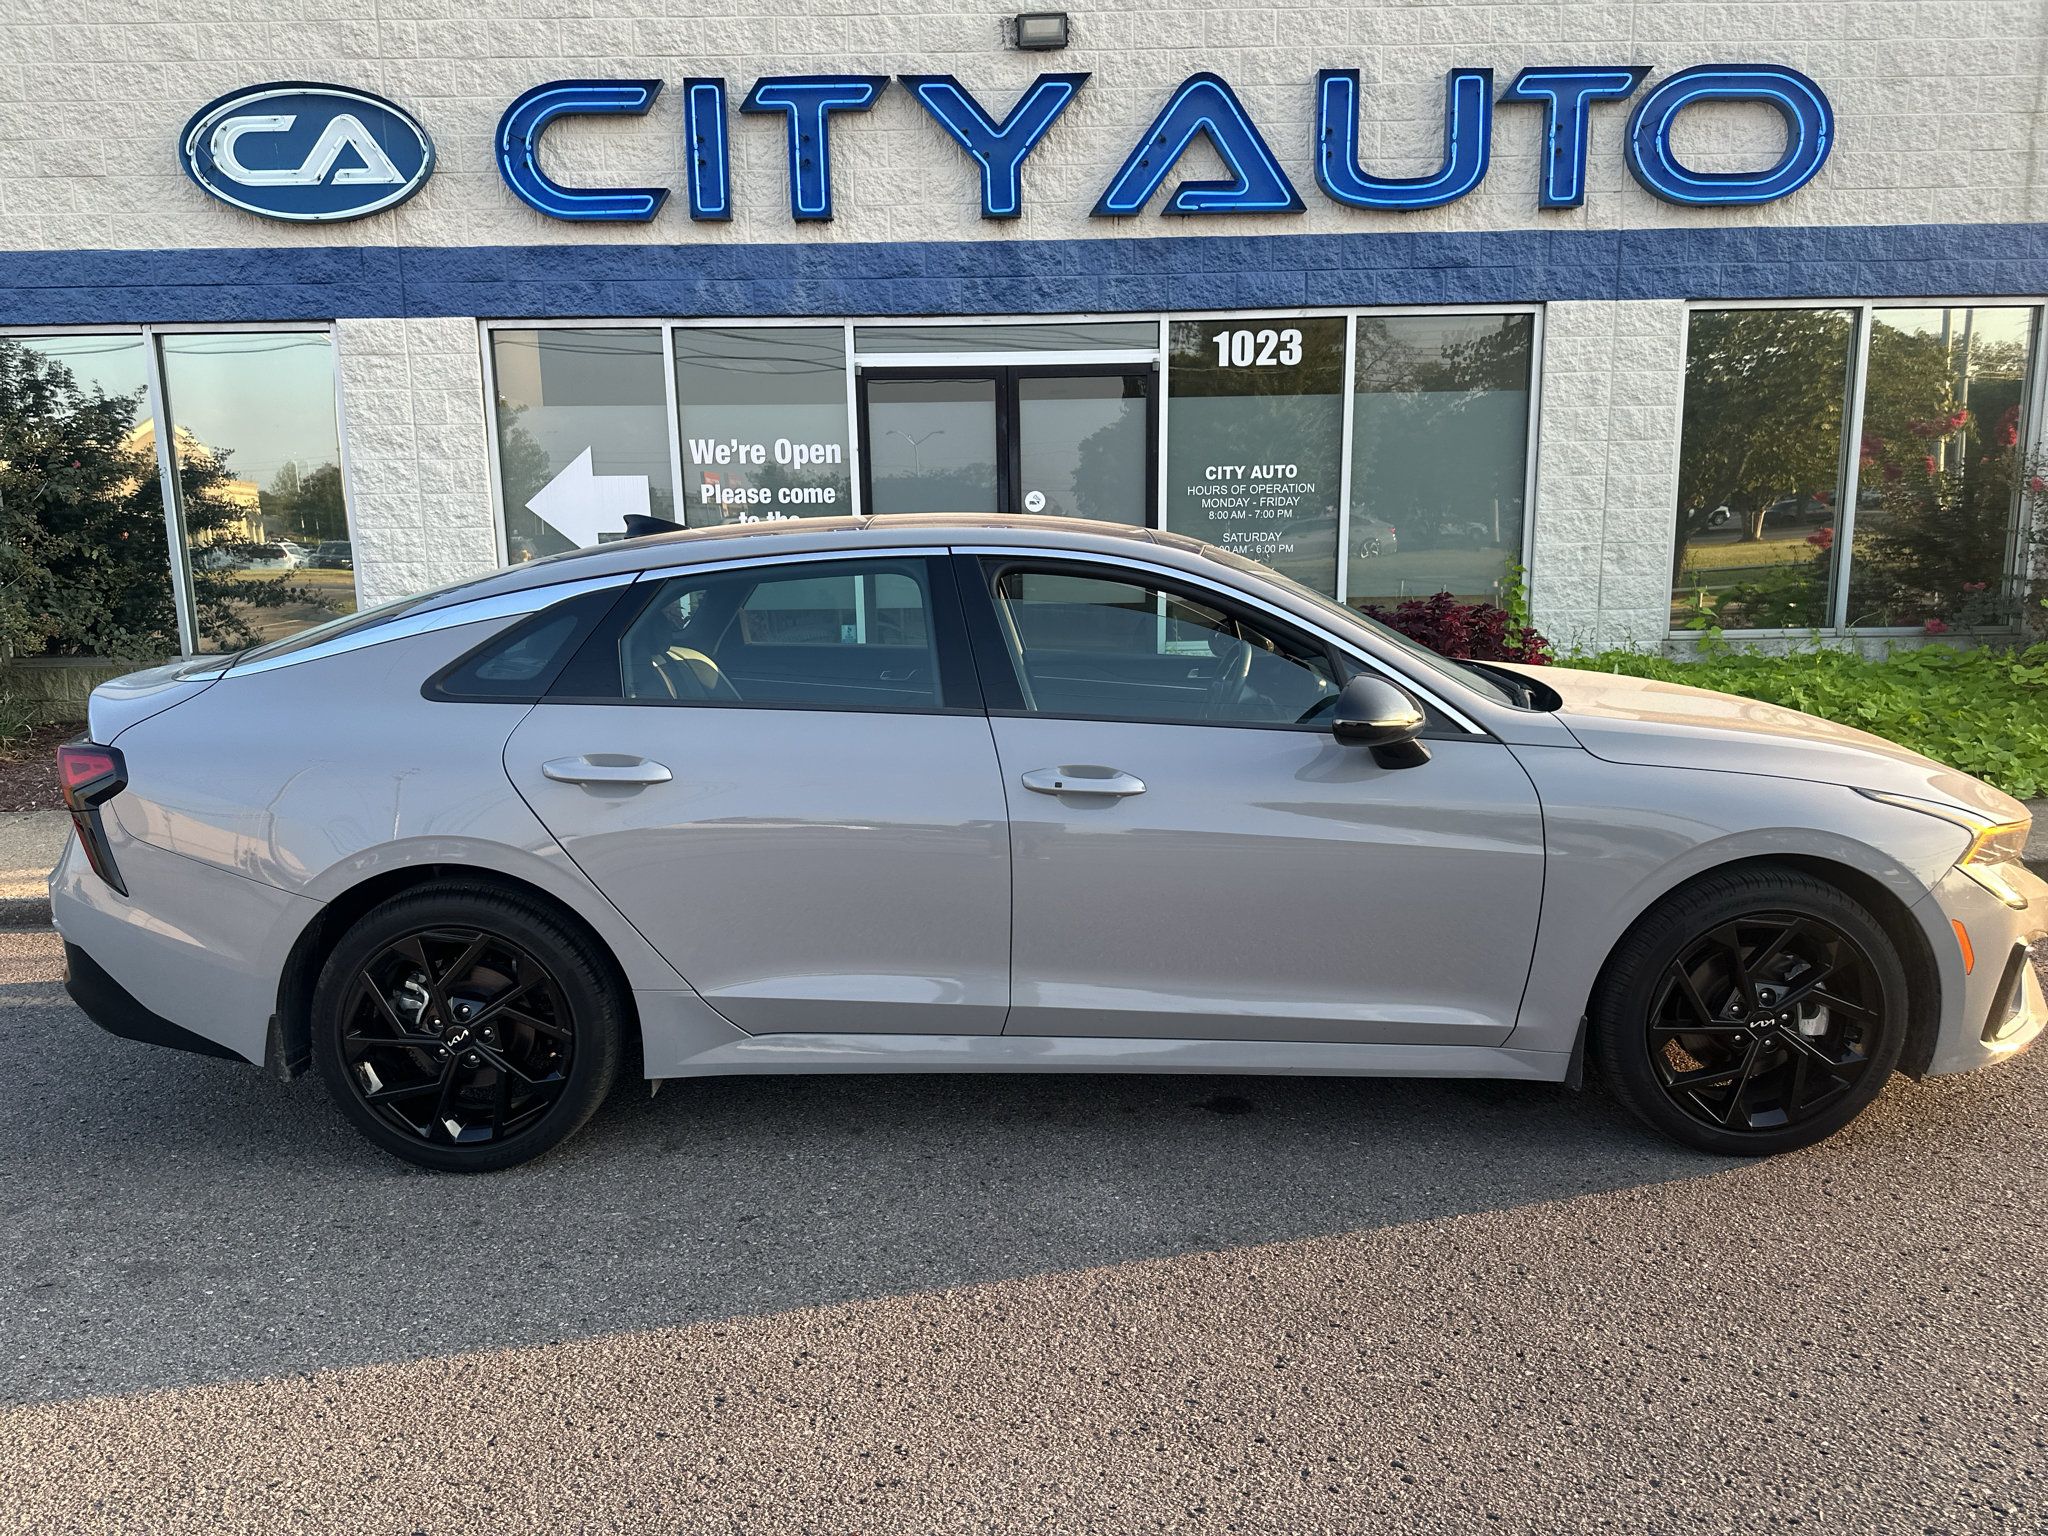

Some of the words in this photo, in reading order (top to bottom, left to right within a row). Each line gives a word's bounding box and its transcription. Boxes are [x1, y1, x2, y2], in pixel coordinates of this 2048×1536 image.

[211, 112, 407, 186] CA
[496, 74, 1091, 222] CITY
[1090, 63, 1836, 218] AUTO
[1213, 329, 1303, 367] 1023
[774, 438, 842, 470] Open
[1205, 466, 1246, 480] CITY
[1250, 464, 1298, 479] AUTO
[700, 484, 771, 504] Please
[778, 487, 836, 504] come
[1187, 485, 1228, 496] HOURS
[1230, 485, 1247, 495] OF
[1249, 483, 1316, 494] OPERATION
[1201, 498, 1250, 508] MONDAY
[1260, 497, 1301, 507] FRIDAY
[1208, 511, 1229, 520] 8:00
[1230, 511, 1246, 519] AM
[1255, 510, 1275, 519] 7:00
[1278, 510, 1293, 518] PM
[1222, 532, 1282, 542] SATURDAY
[1232, 546, 1248, 554] AM
[1255, 545, 1276, 554] 6:00
[1278, 544, 1294, 553] PM
